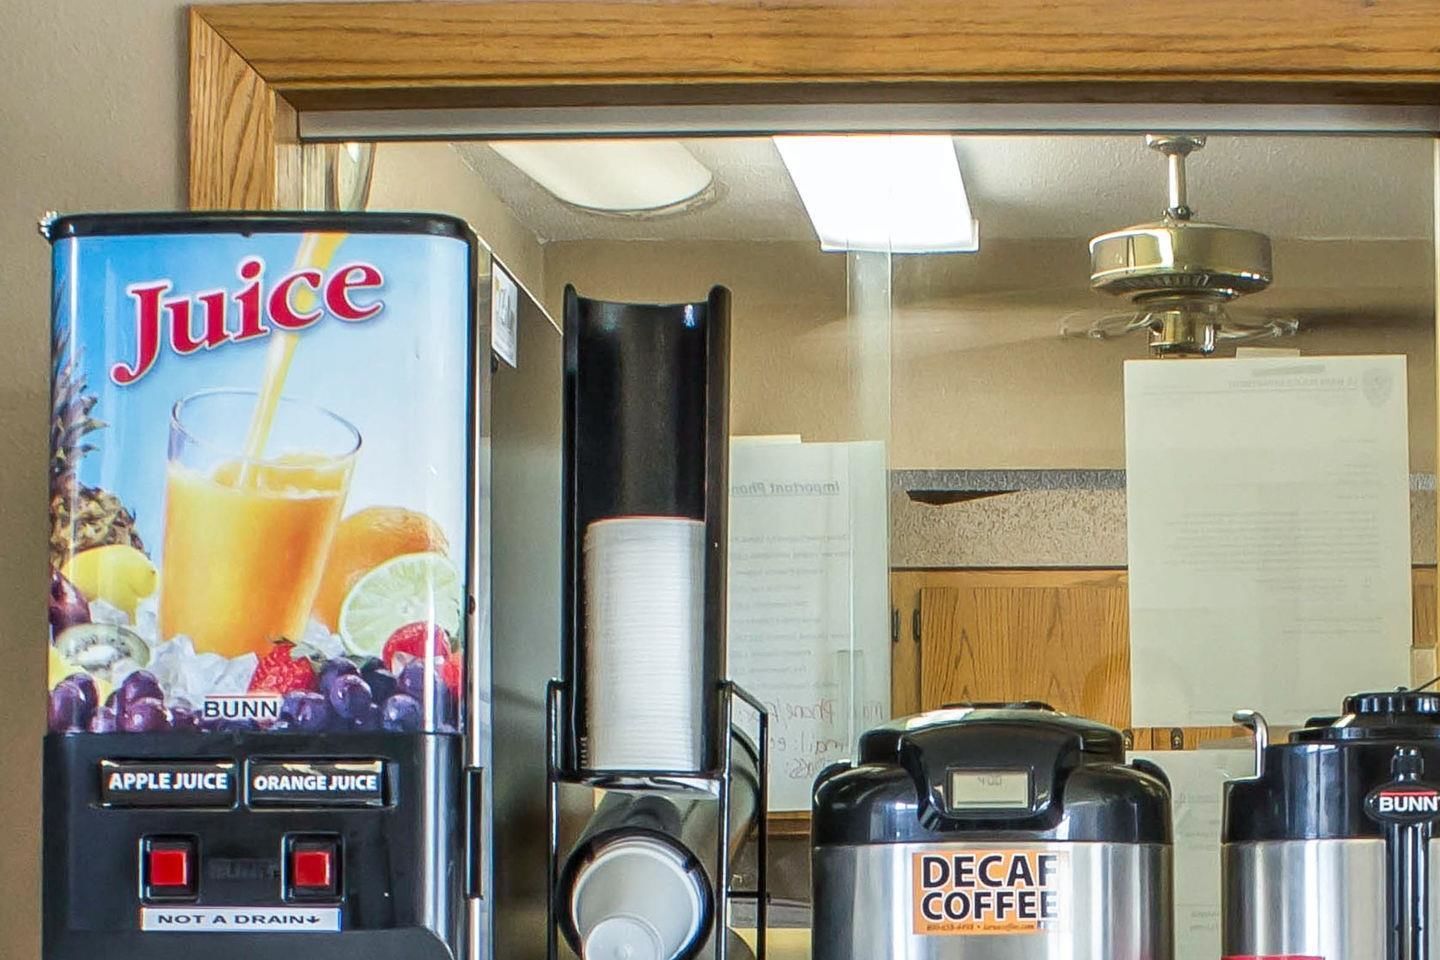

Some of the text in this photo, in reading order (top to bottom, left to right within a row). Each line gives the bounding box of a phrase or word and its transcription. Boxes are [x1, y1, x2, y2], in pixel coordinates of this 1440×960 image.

[111, 256, 384, 384] Juice
[204, 701, 278, 718] BUNN
[109, 773, 228, 789] APPLE JUICE
[254, 775, 377, 790] ORANGE JUICE
[1379, 796, 1439, 812] BUNN
[922, 854, 1058, 889] DECAF
[921, 890, 1058, 920] COFFEE
[158, 915, 306, 924] NOT A DRAIN
